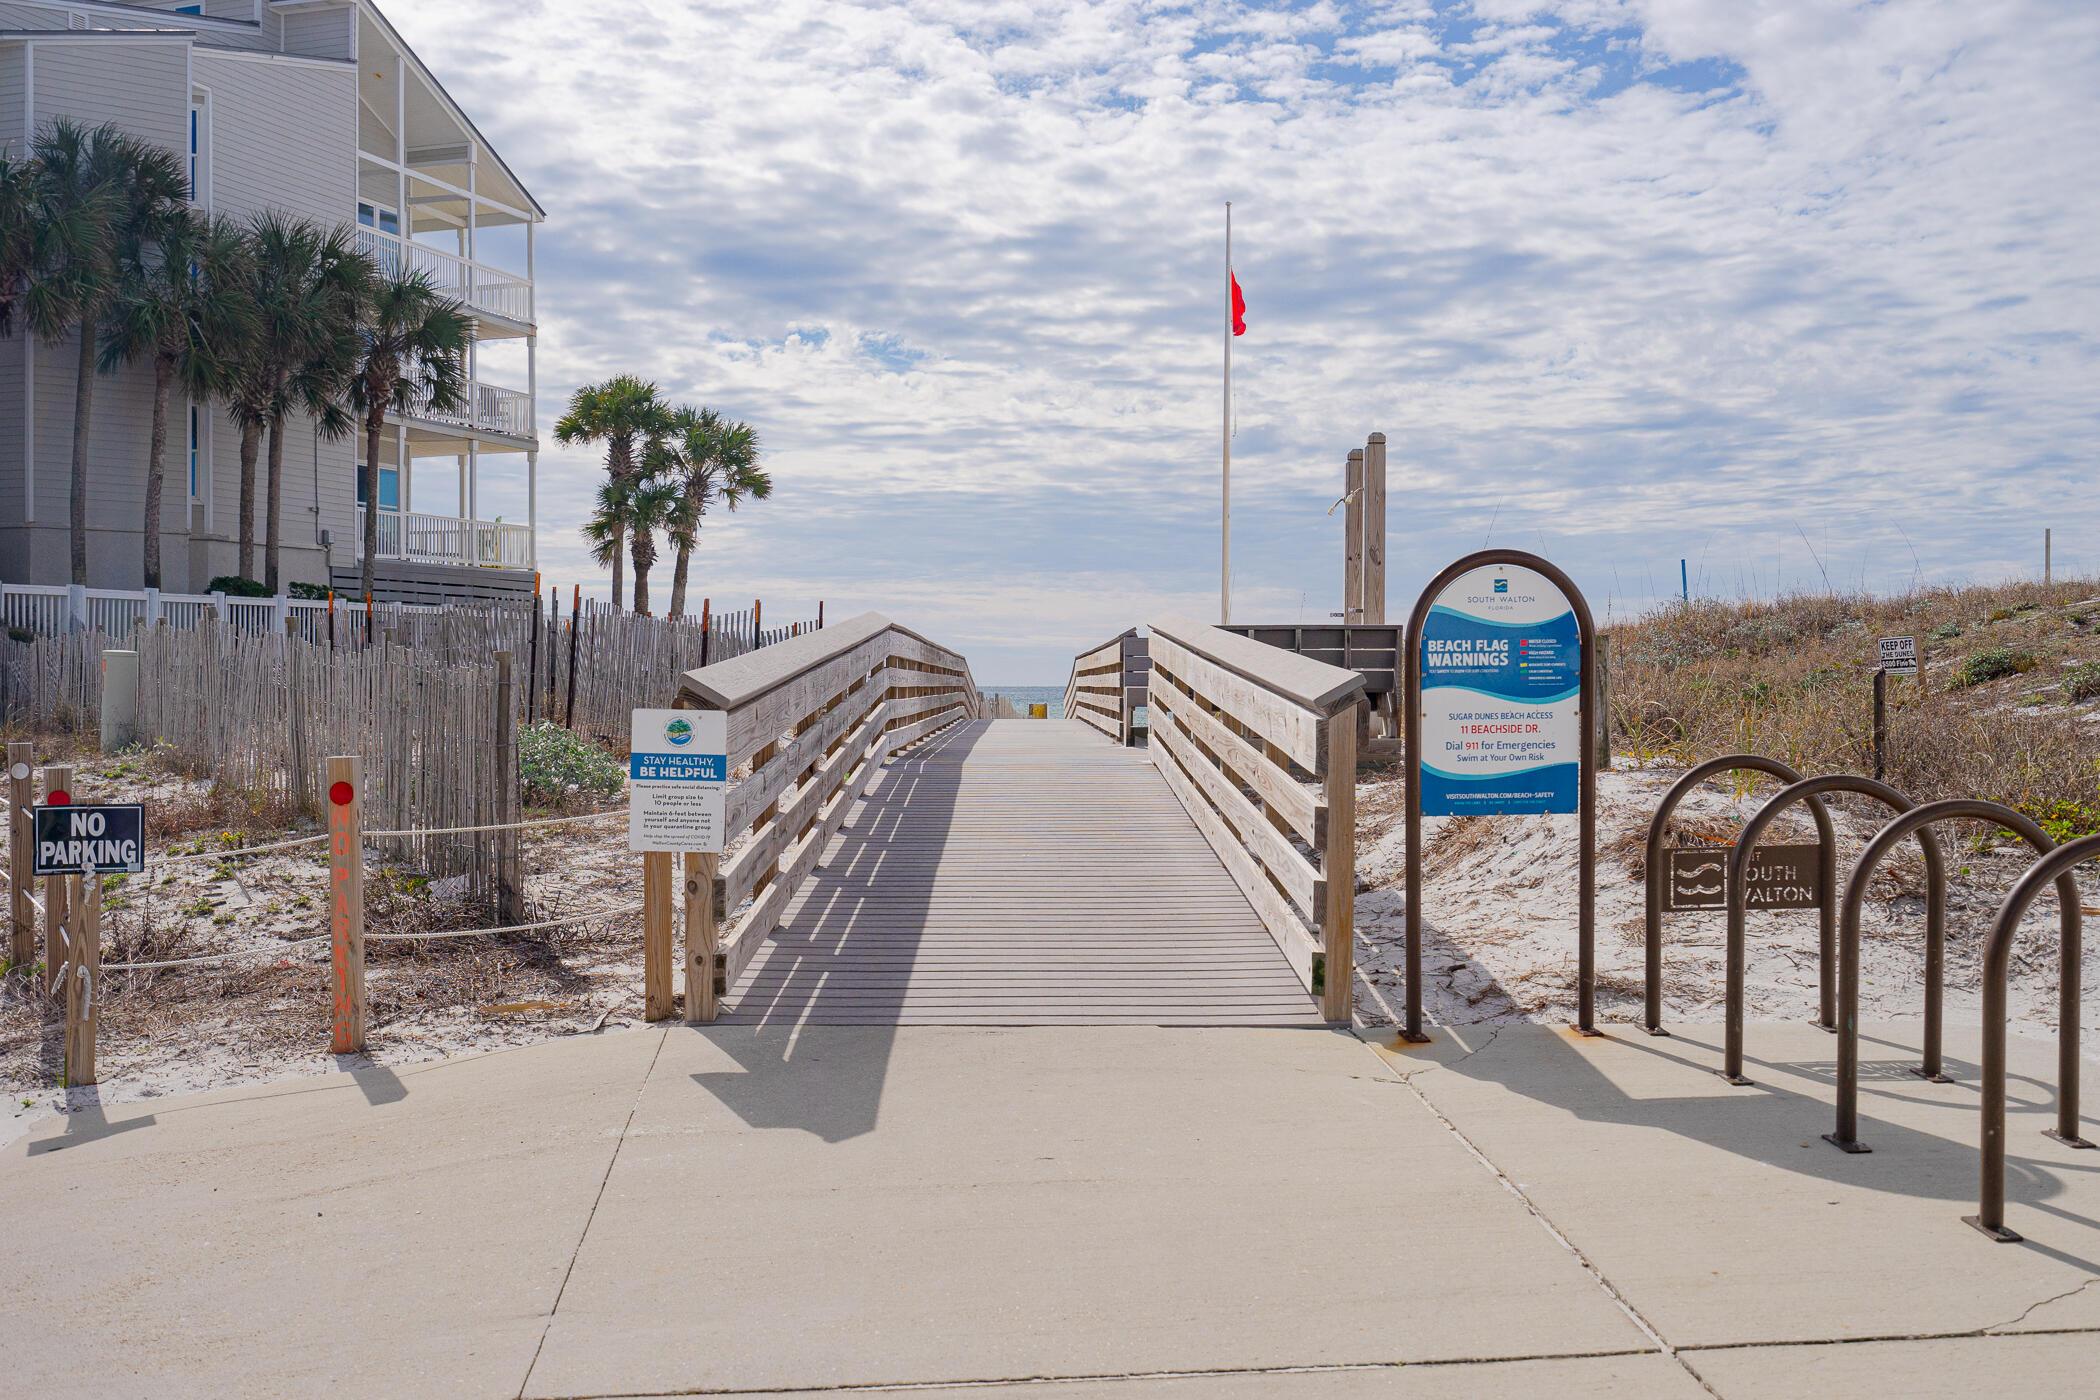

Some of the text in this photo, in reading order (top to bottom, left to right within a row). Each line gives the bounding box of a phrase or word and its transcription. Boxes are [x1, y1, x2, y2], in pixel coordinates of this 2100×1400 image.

[1467, 596, 1495, 604] SOUTH
[1428, 639, 1508, 651] BEACH FLAG
[1881, 640, 1912, 651] KEEP OFF
[1428, 652, 1508, 667] WARNINGS
[1475, 712, 1499, 720] DUNES
[1501, 712, 1524, 720] BEACH
[1461, 724, 1541, 734] 11 BEACHSIDE DR.
[1445, 740, 1555, 752] Dial 911 for Emergencies
[644, 756, 714, 767] STAY HEALTHY,
[1457, 754, 1478, 762] Swim
[1529, 753, 1544, 761] Risk
[640, 767, 717, 778] BE HELPFUL
[71, 812, 105, 837] NO
[40, 840, 136, 865] PARKING
[1745, 865, 1797, 881] OUTH
[1744, 886, 1813, 903] ALTON
[333, 804, 352, 1045] NO PARKING
